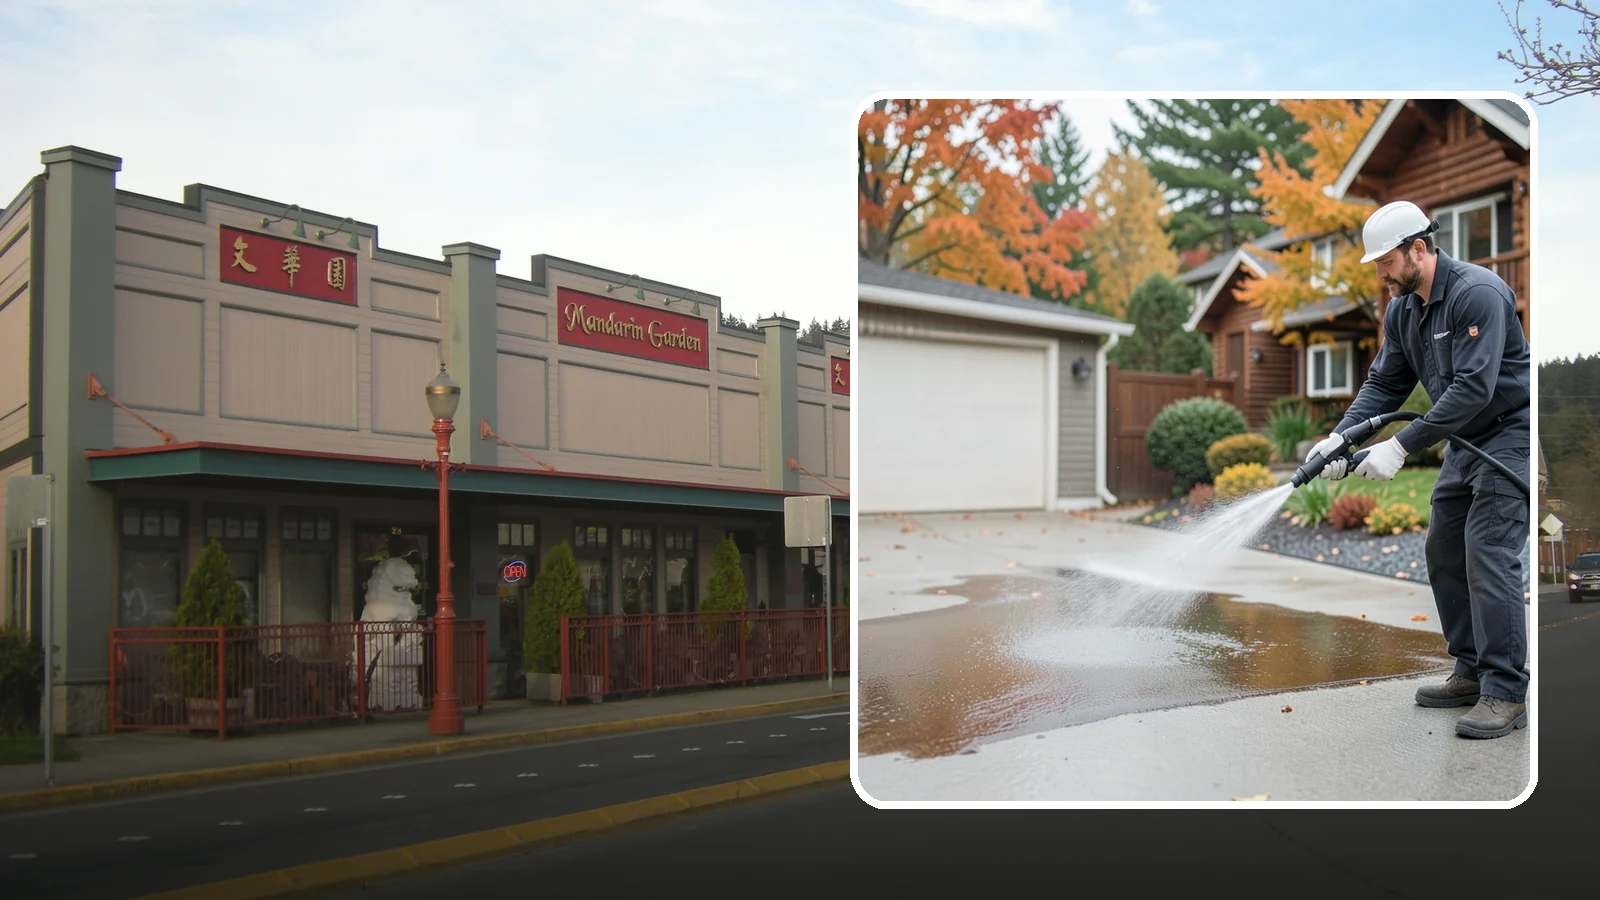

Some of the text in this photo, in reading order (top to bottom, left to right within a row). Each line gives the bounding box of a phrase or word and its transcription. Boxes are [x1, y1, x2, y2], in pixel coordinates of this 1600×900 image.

[231, 236, 346, 291] 文華園
[564, 302, 702, 352] Mandarin Garden
[503, 565, 527, 578] OPEN
